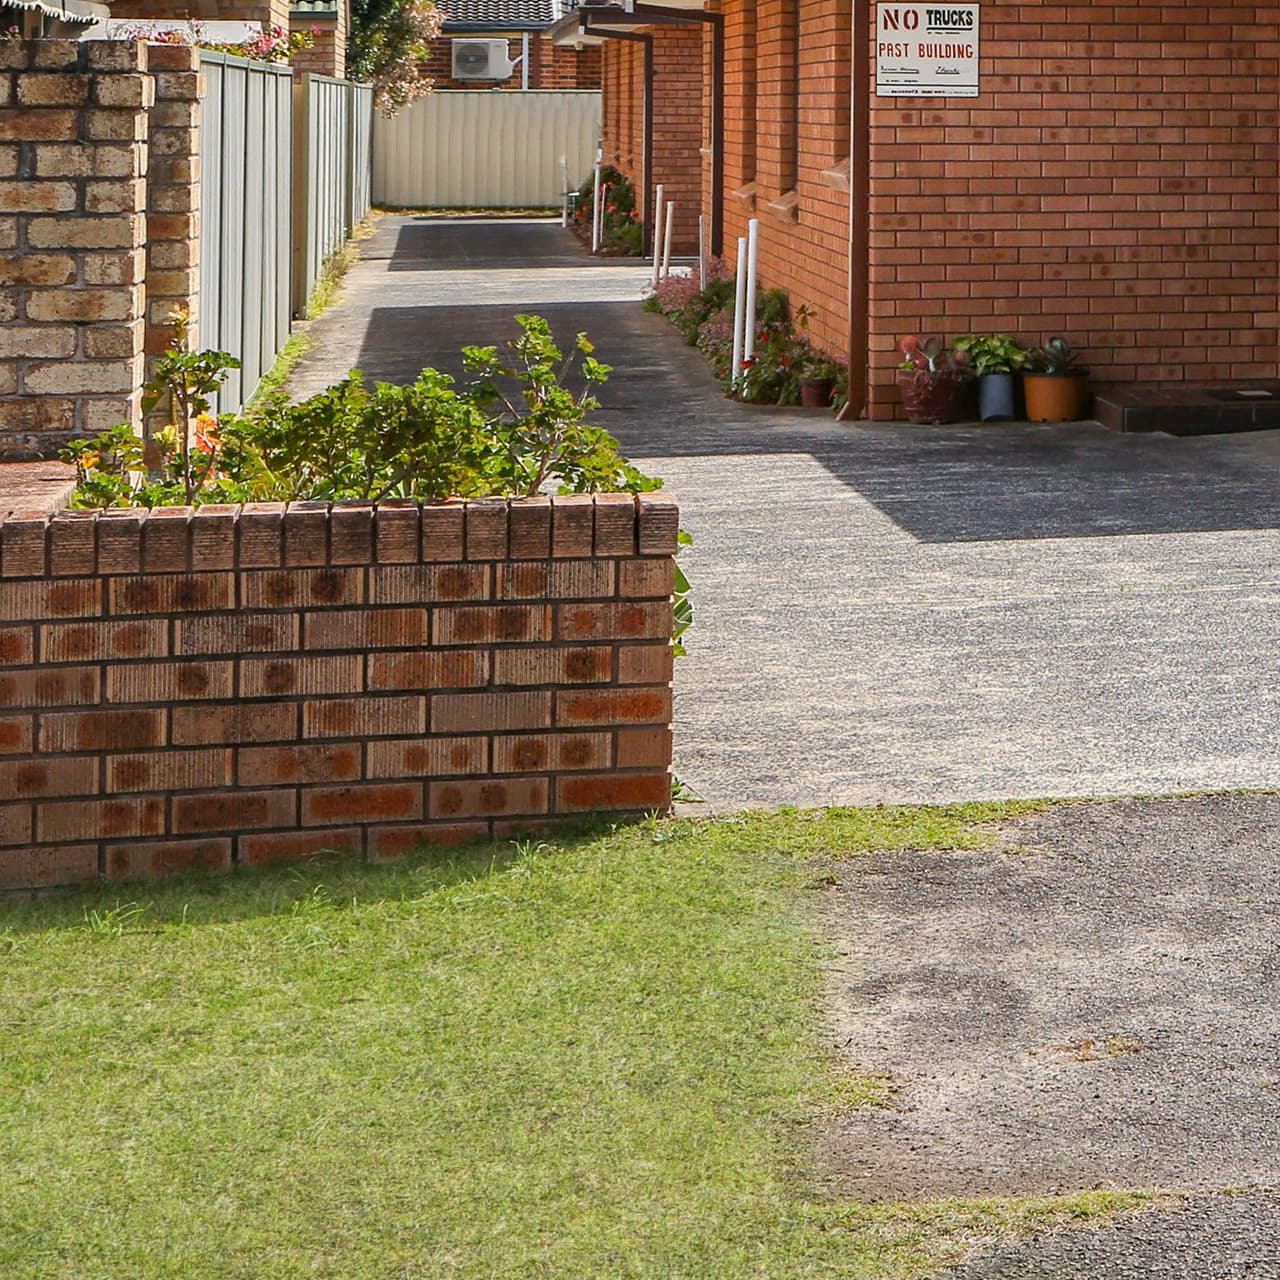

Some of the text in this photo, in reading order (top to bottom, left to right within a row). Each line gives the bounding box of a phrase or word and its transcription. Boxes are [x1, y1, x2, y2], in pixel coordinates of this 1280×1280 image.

[883, 9, 973, 30] NO TRUCKS
[879, 43, 973, 59] PAST BUILDING
